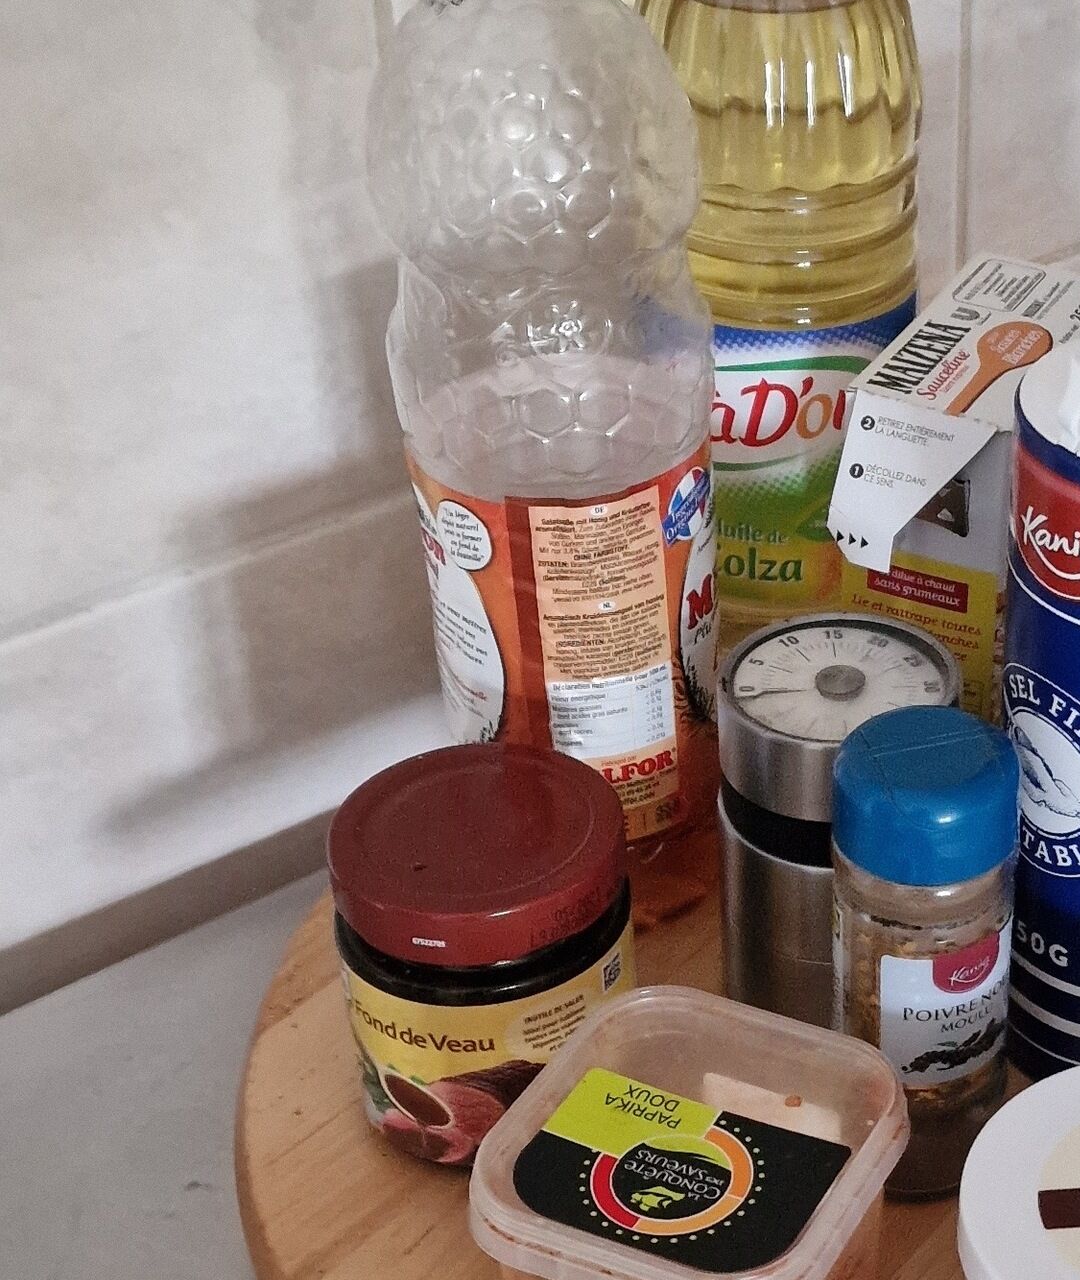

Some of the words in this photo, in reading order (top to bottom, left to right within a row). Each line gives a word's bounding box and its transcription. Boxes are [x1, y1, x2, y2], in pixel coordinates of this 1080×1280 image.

[866, 319, 972, 395] MAIZENA
[916, 349, 971, 401] Sauceline
[875, 425, 884, 434] LA
[718, 520, 762, 540] uile
[716, 543, 803, 583] olza
[874, 577, 901, 592] sans
[902, 583, 961, 607] grumeaux
[924, 579, 956, 593] chaud
[778, 635, 800, 648] 10
[824, 629, 844, 640] 15
[942, 619, 982, 636] toutes
[749, 657, 765, 667] 5
[738, 685, 755, 693] 0
[1008, 673, 1042, 706] SEL
[602, 749, 674, 784] LFOR
[1015, 919, 1070, 969] 50G
[949, 956, 991, 987] Kania
[903, 999, 978, 1022] POIVRE
[353, 999, 398, 1040] Fond
[399, 1028, 427, 1049] de
[427, 1032, 496, 1053] Veau
[604, 1092, 682, 1130] PAPRIKA
[624, 1084, 680, 1113] DOUX
